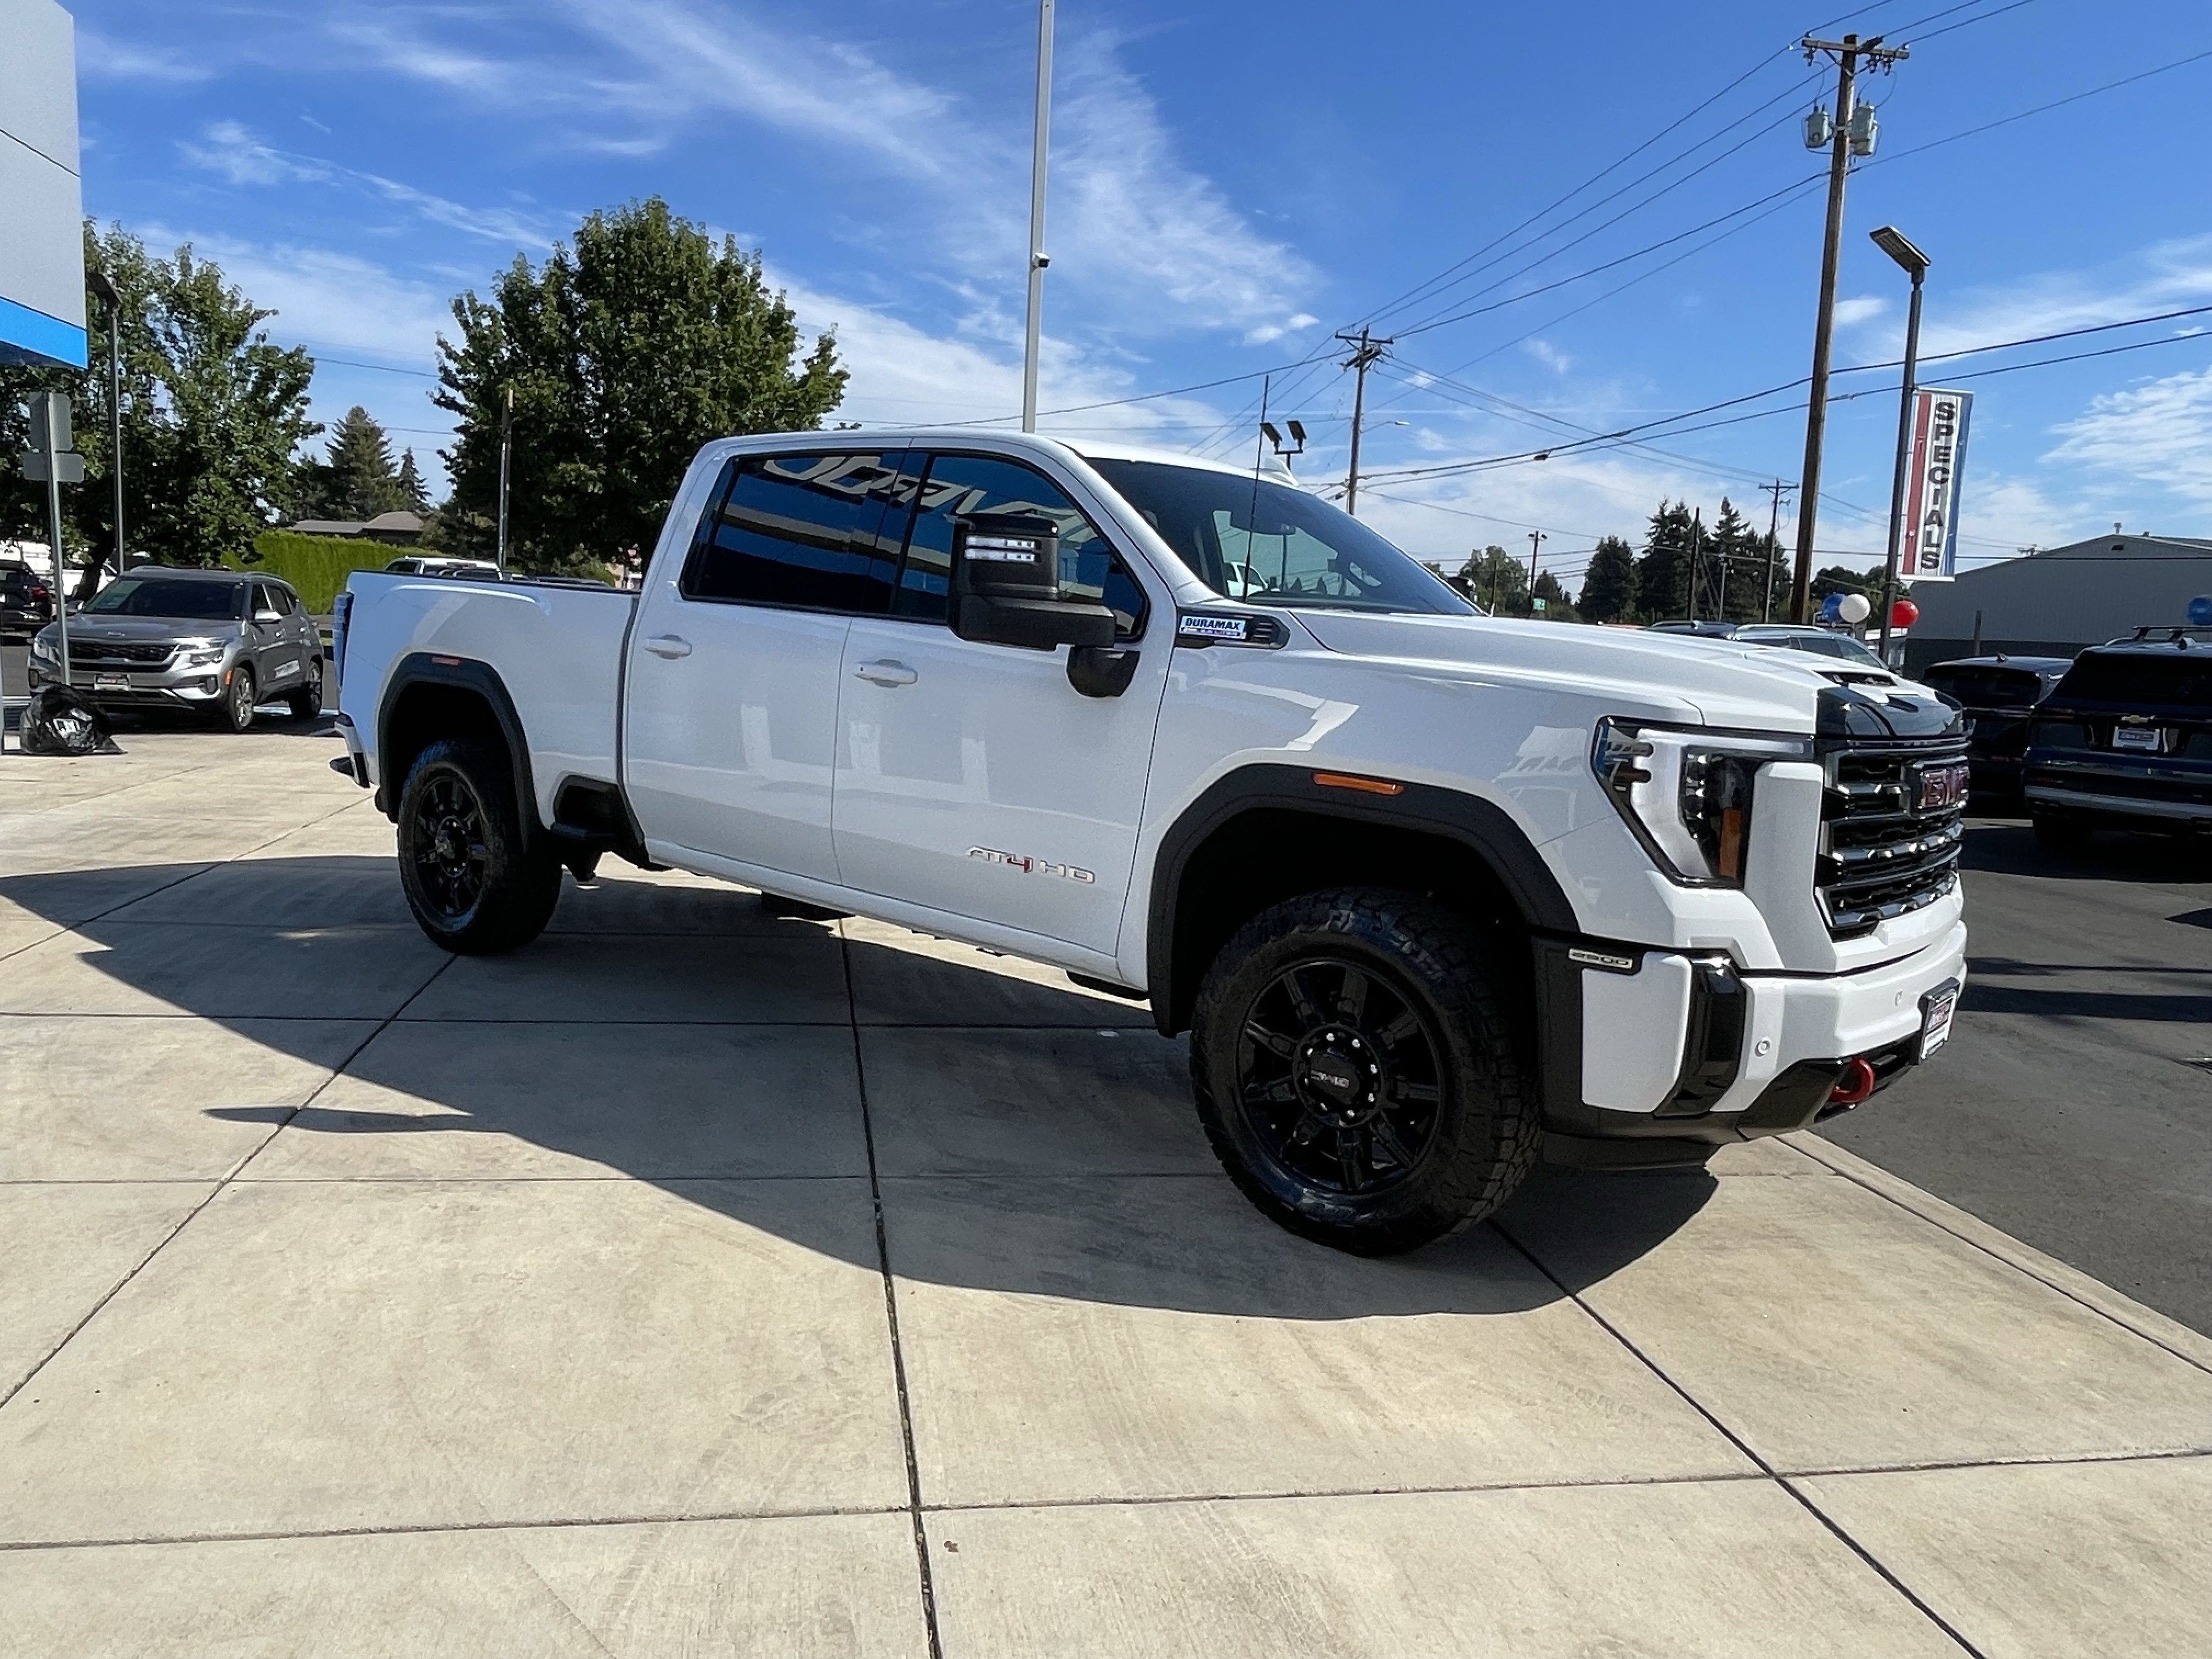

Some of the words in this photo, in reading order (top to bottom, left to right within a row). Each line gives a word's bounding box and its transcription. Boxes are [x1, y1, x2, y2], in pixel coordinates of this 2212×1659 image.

[1921, 402, 1955, 569] SPECIALS
[1185, 618, 1241, 630] DURAMAX
[966, 845, 1034, 873] AT4
[1040, 859, 1096, 884] HD
